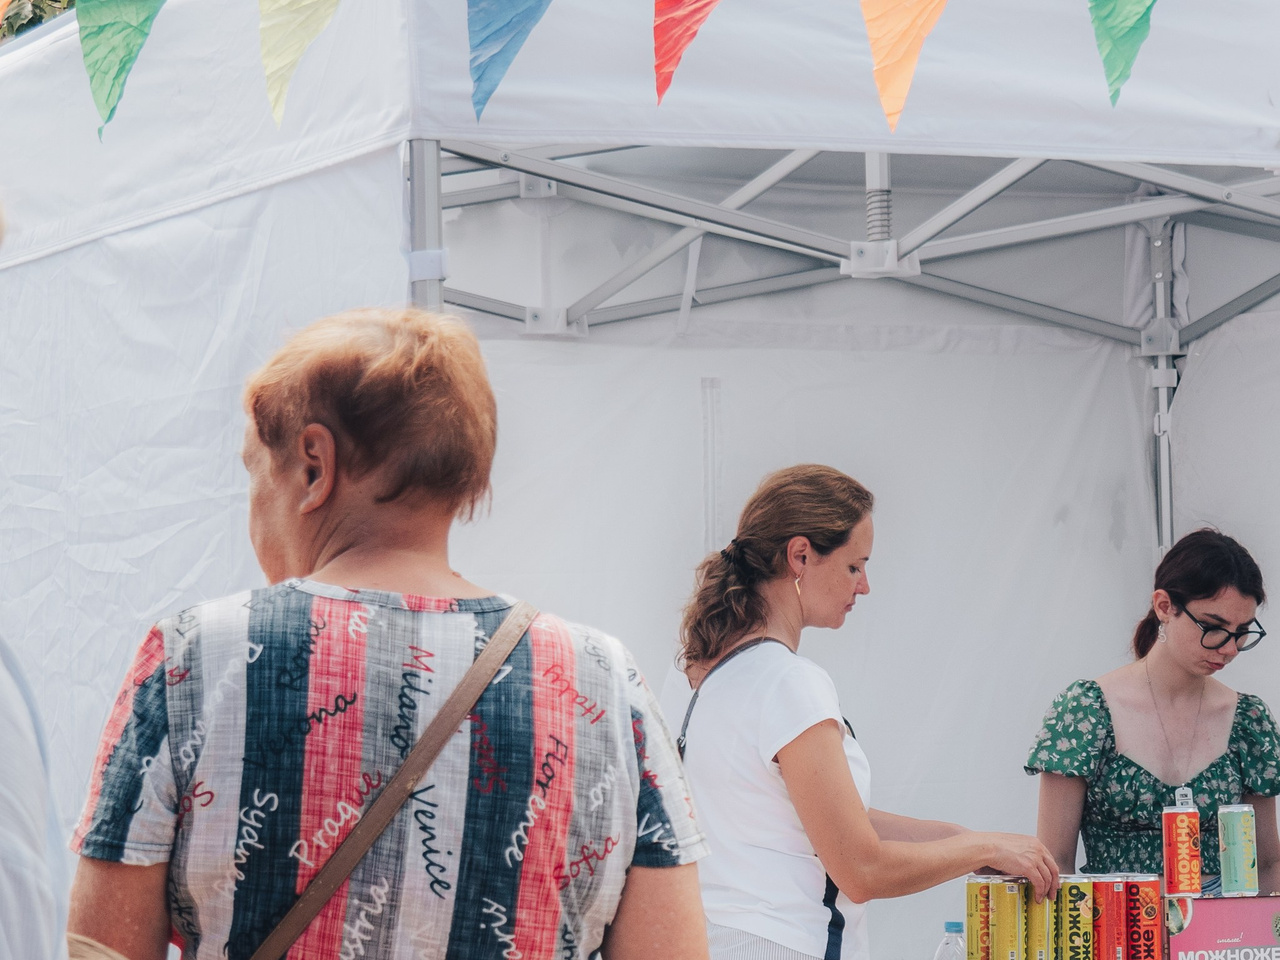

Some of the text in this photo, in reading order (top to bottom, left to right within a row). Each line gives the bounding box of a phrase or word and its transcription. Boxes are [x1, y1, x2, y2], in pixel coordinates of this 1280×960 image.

[388, 645, 435, 758] Milano
[542, 664, 606, 725] Italy
[212, 787, 279, 899] Sydney
[289, 769, 382, 867] Prague
[407, 783, 452, 900] Venice
[504, 734, 569, 869] Florence
[553, 832, 621, 891] Sofia
